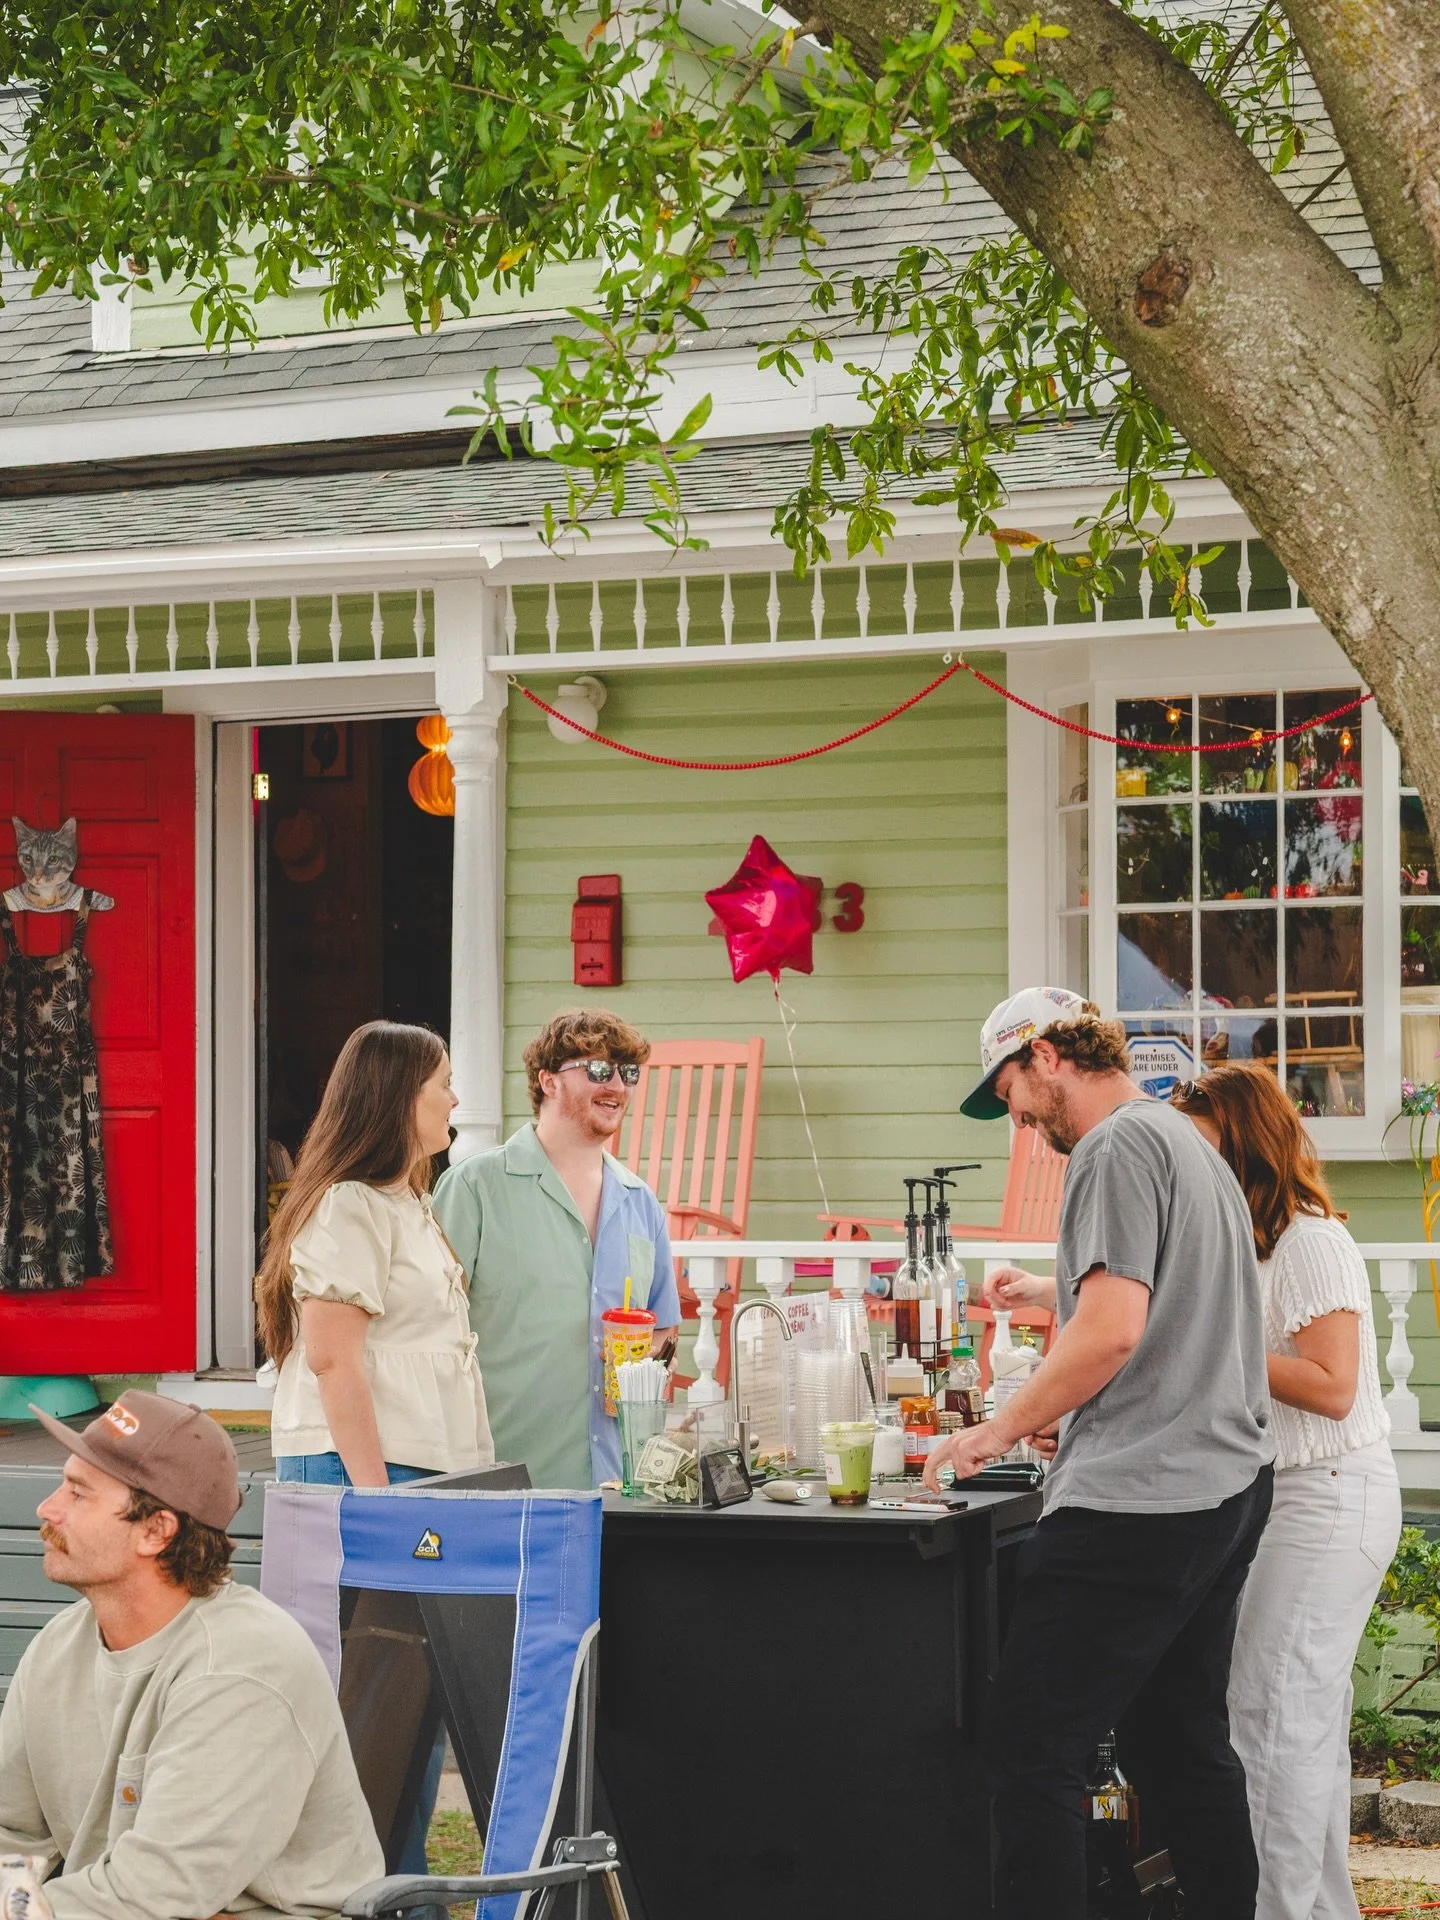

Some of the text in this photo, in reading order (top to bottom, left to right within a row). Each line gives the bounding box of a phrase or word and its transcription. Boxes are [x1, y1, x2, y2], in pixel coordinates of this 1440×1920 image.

[1134, 1053, 1176, 1062] PREMISES
[1133, 1064, 1179, 1072] ARE UNDER
[788, 1303, 809, 1319] COFFEE
[791, 1320, 806, 1334] MENU
